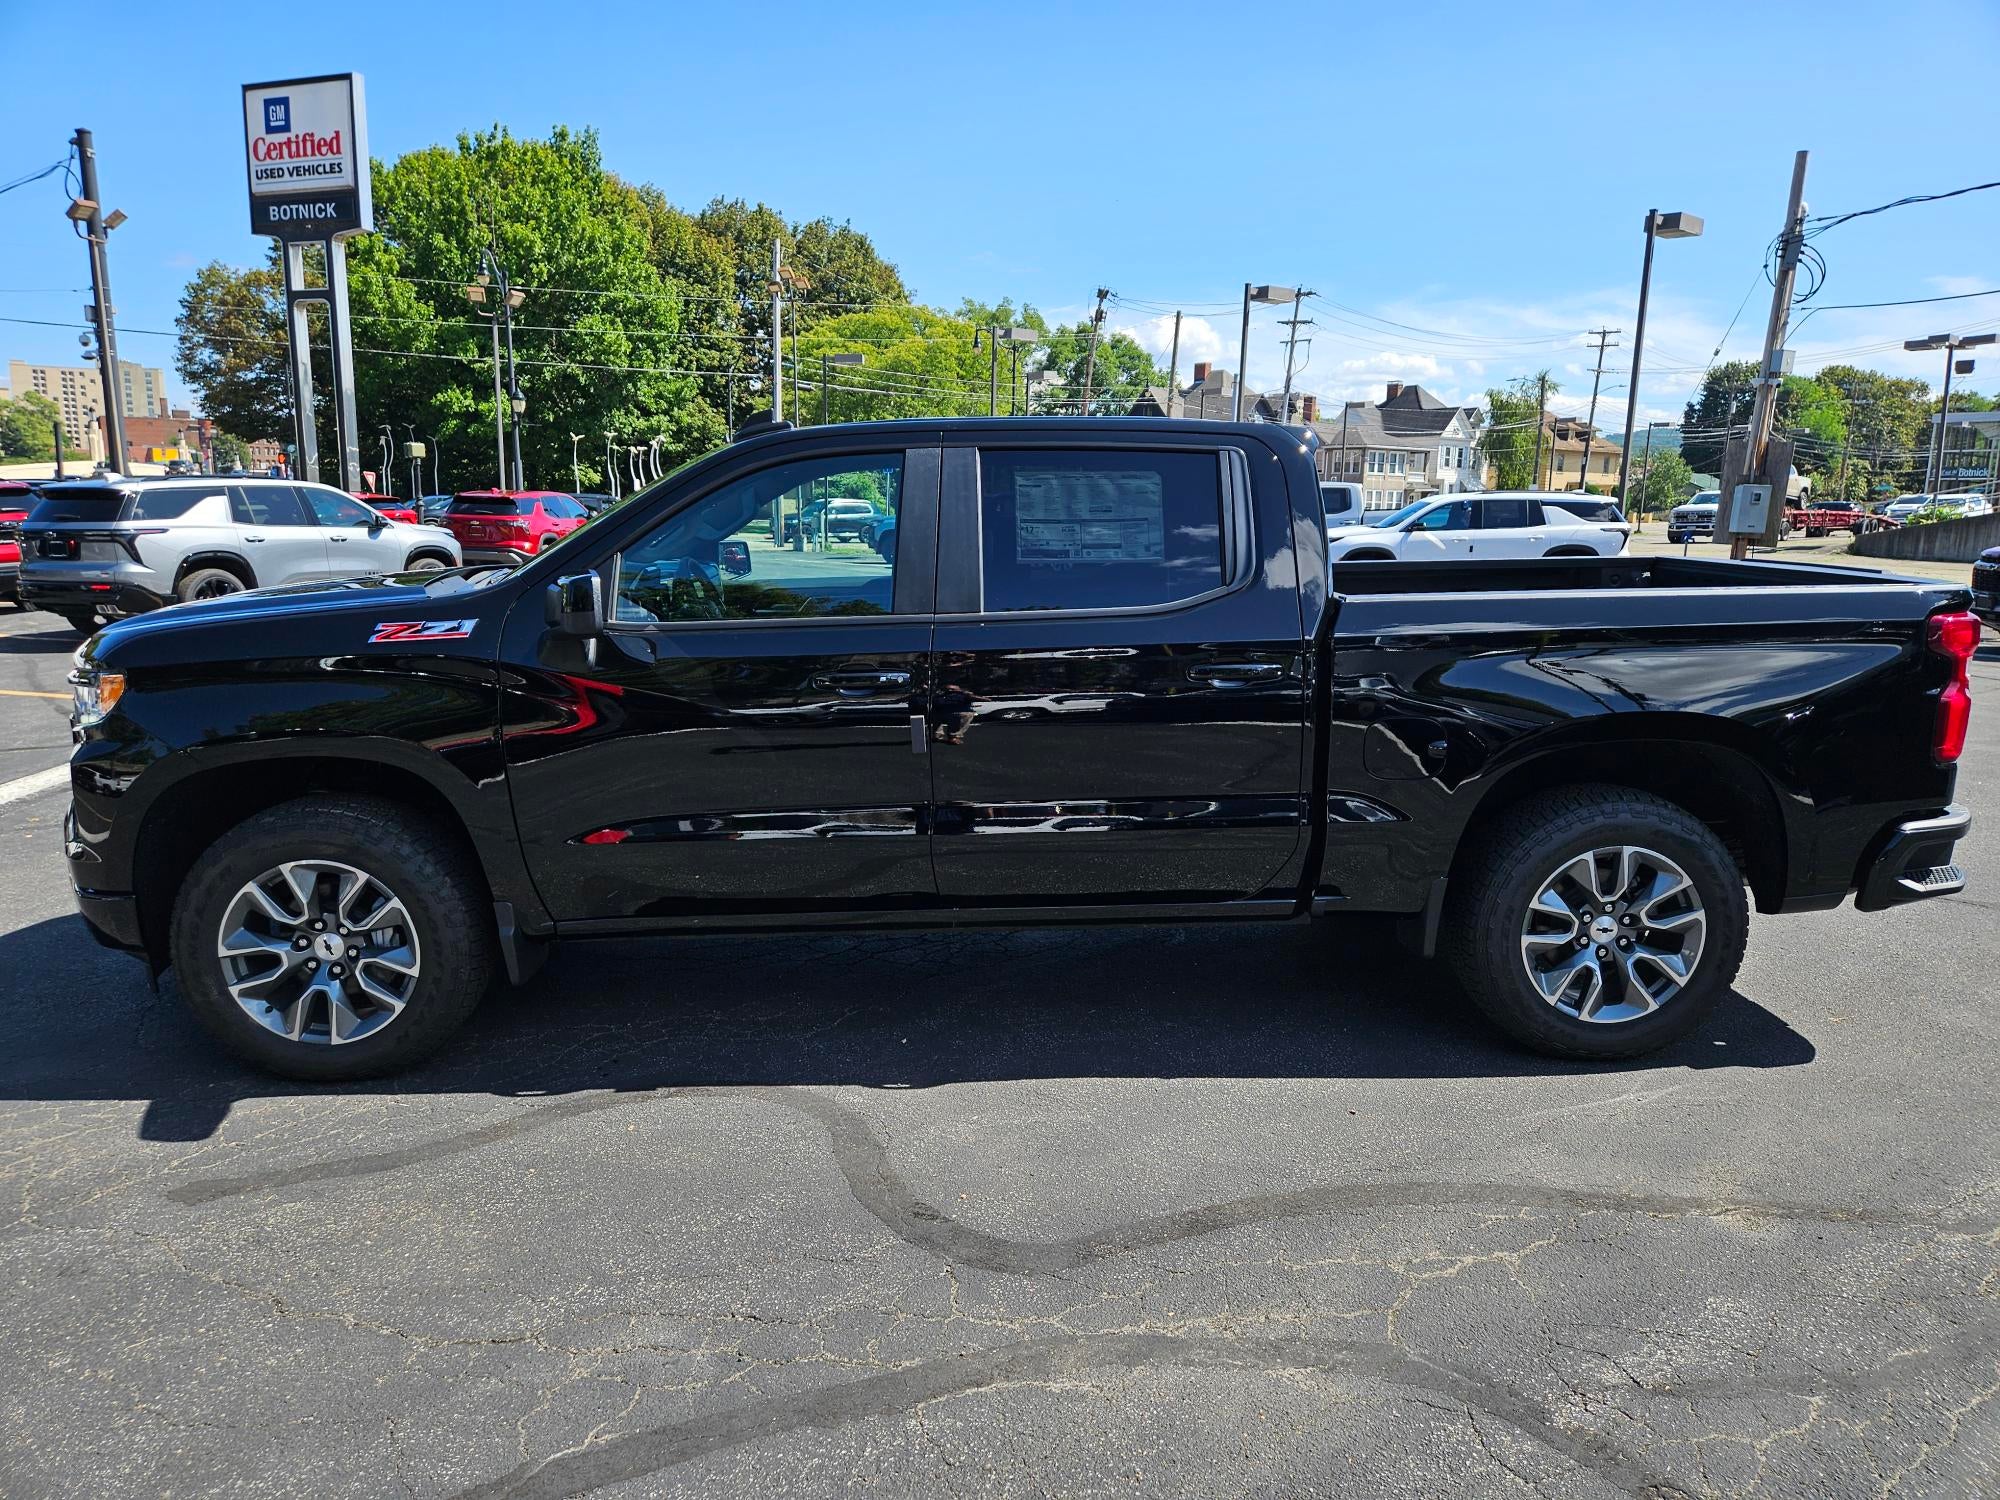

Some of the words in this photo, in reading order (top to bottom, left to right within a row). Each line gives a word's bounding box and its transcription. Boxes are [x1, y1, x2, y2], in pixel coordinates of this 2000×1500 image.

[269, 104, 285, 121] GM
[252, 130, 342, 162] Certified
[255, 167, 285, 180] USED
[286, 162, 343, 178] VEHICLES
[269, 202, 337, 221] BOTNICK
